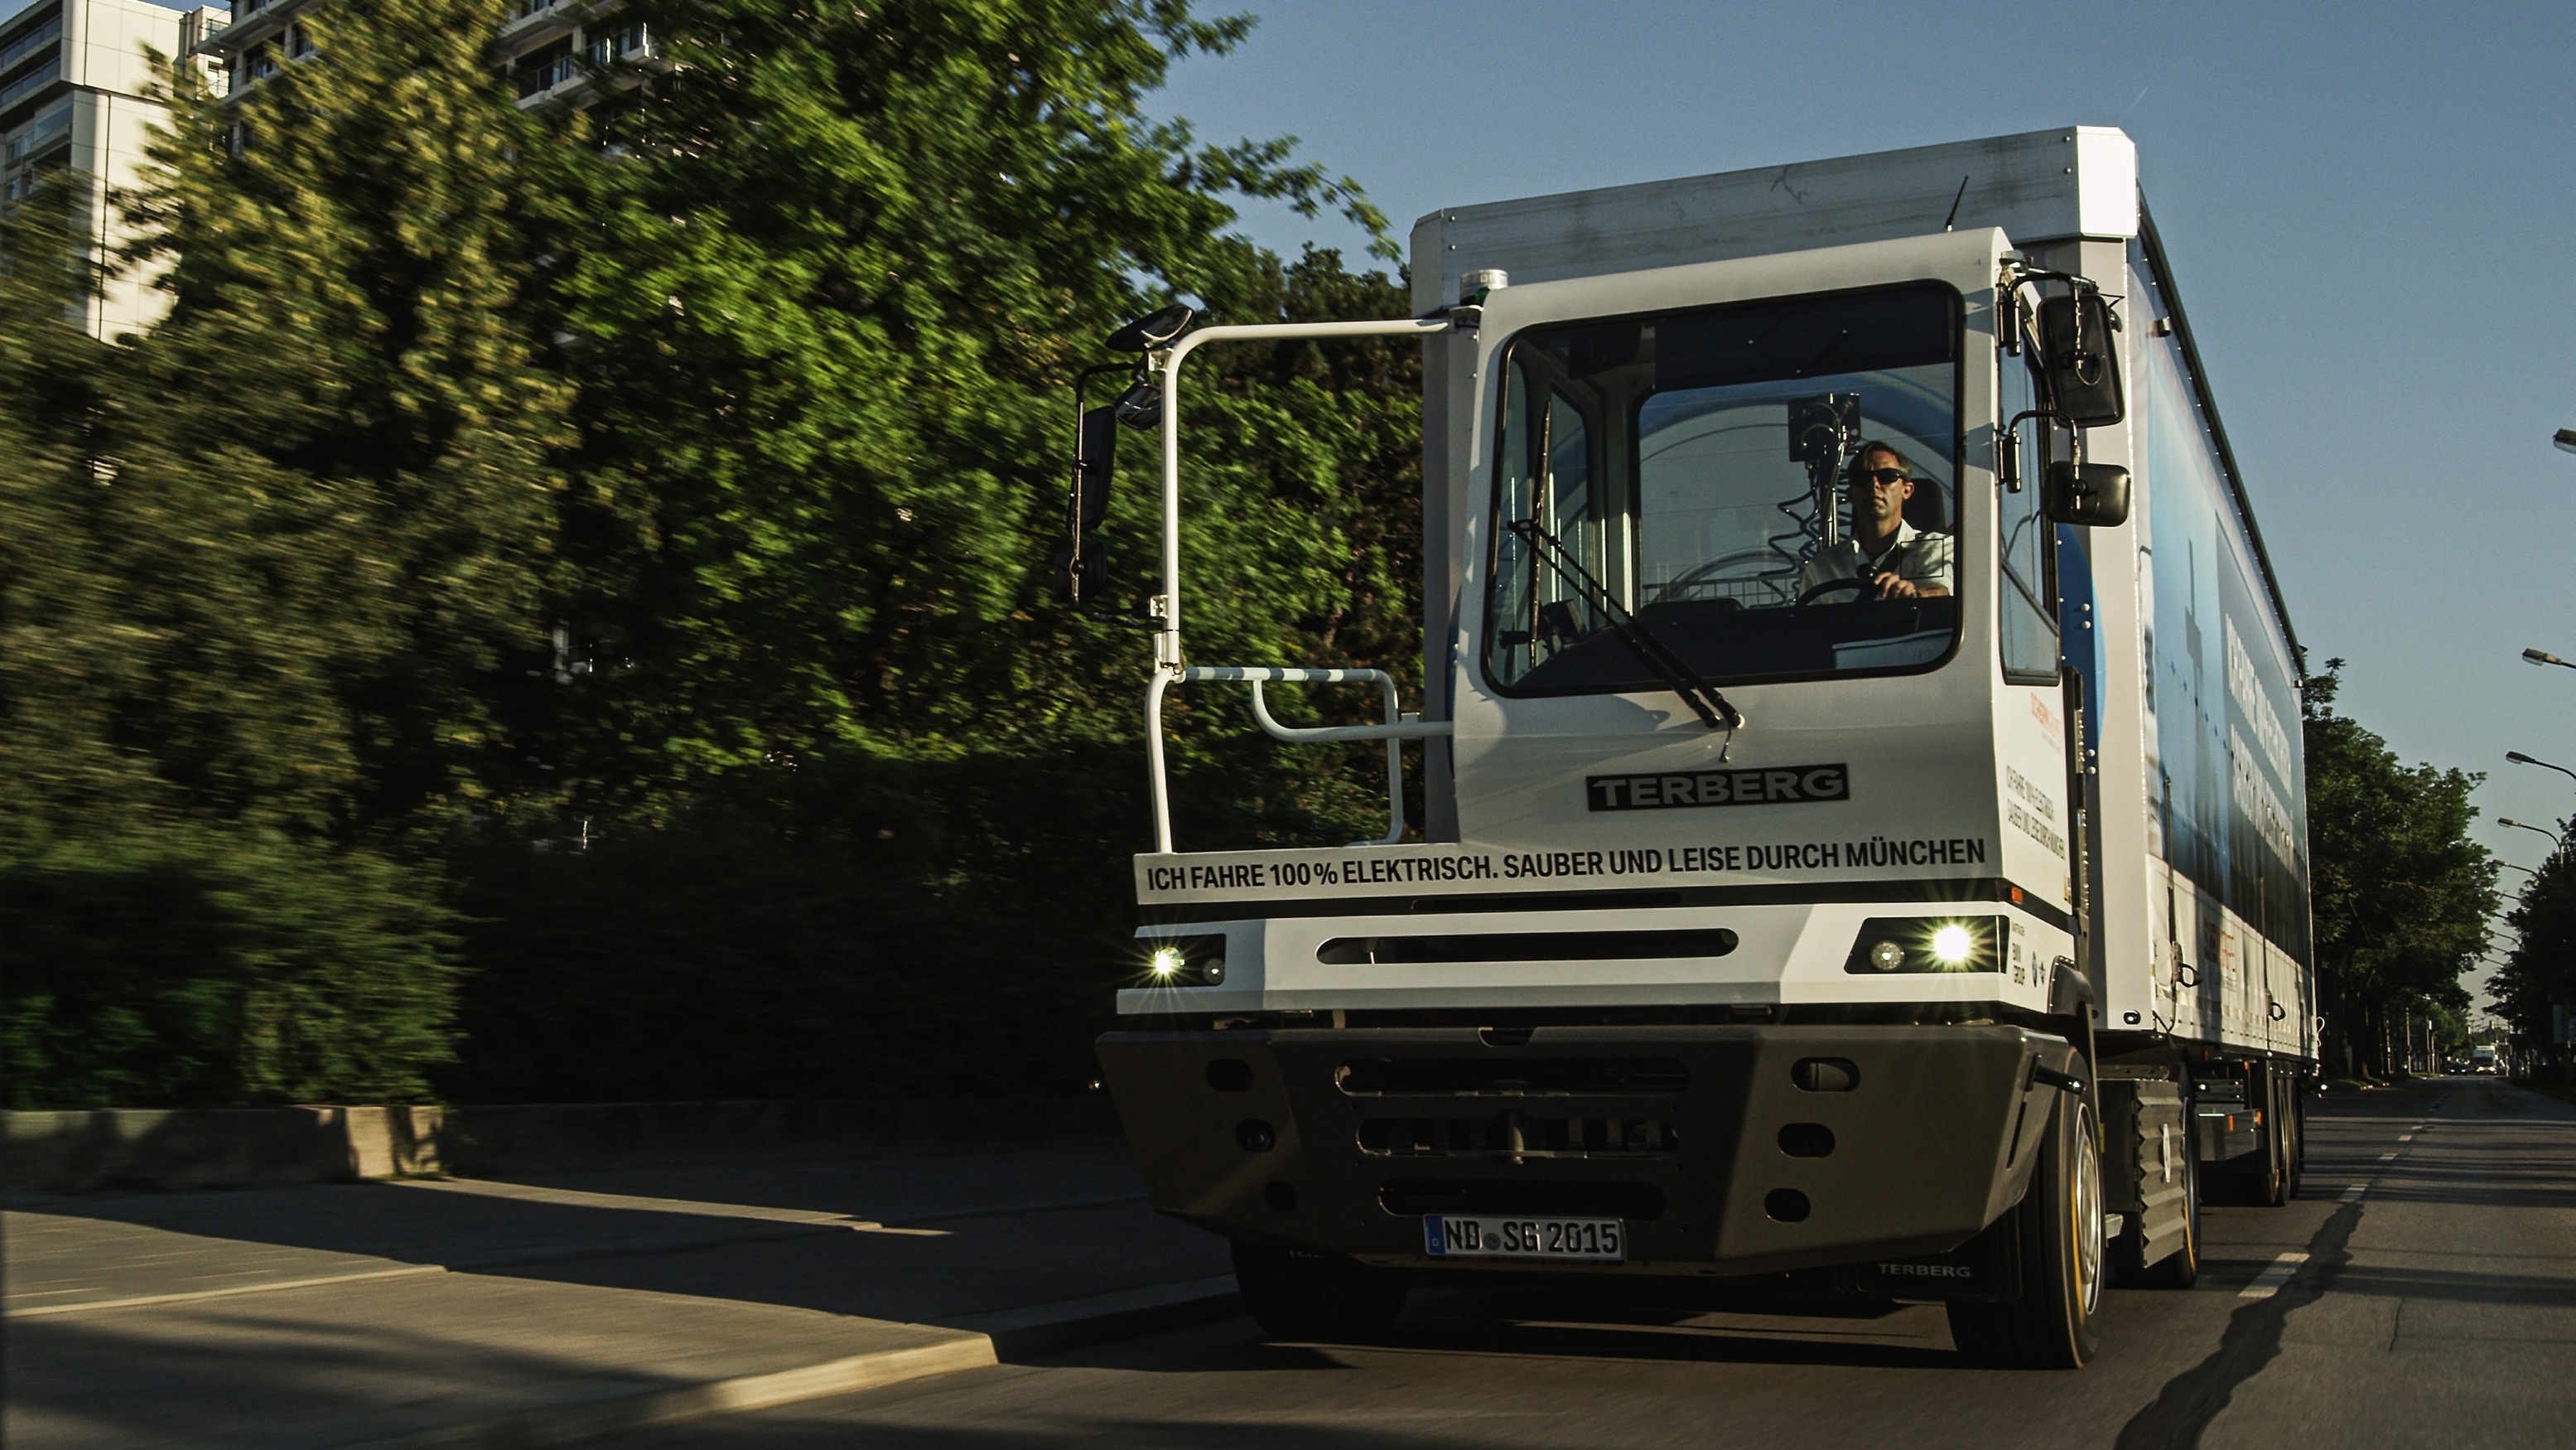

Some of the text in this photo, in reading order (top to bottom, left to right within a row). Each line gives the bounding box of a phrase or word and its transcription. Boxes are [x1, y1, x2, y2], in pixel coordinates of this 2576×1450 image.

[1593, 769, 1844, 807] TERBERG
[1147, 868, 1186, 891] ICH
[1190, 863, 1266, 889] FAHRE
[1342, 855, 1498, 884] ELEKTRISCH.
[1503, 851, 1605, 878] SAUBER
[1609, 848, 1663, 875] UND
[1667, 846, 1742, 872] LEISE
[1746, 843, 1840, 870] DURCH
[1845, 836, 1986, 868] MÜNCHEN
[1444, 1220, 1618, 1254] ND SG 2015
[1879, 1263, 1971, 1278] TERBERG
